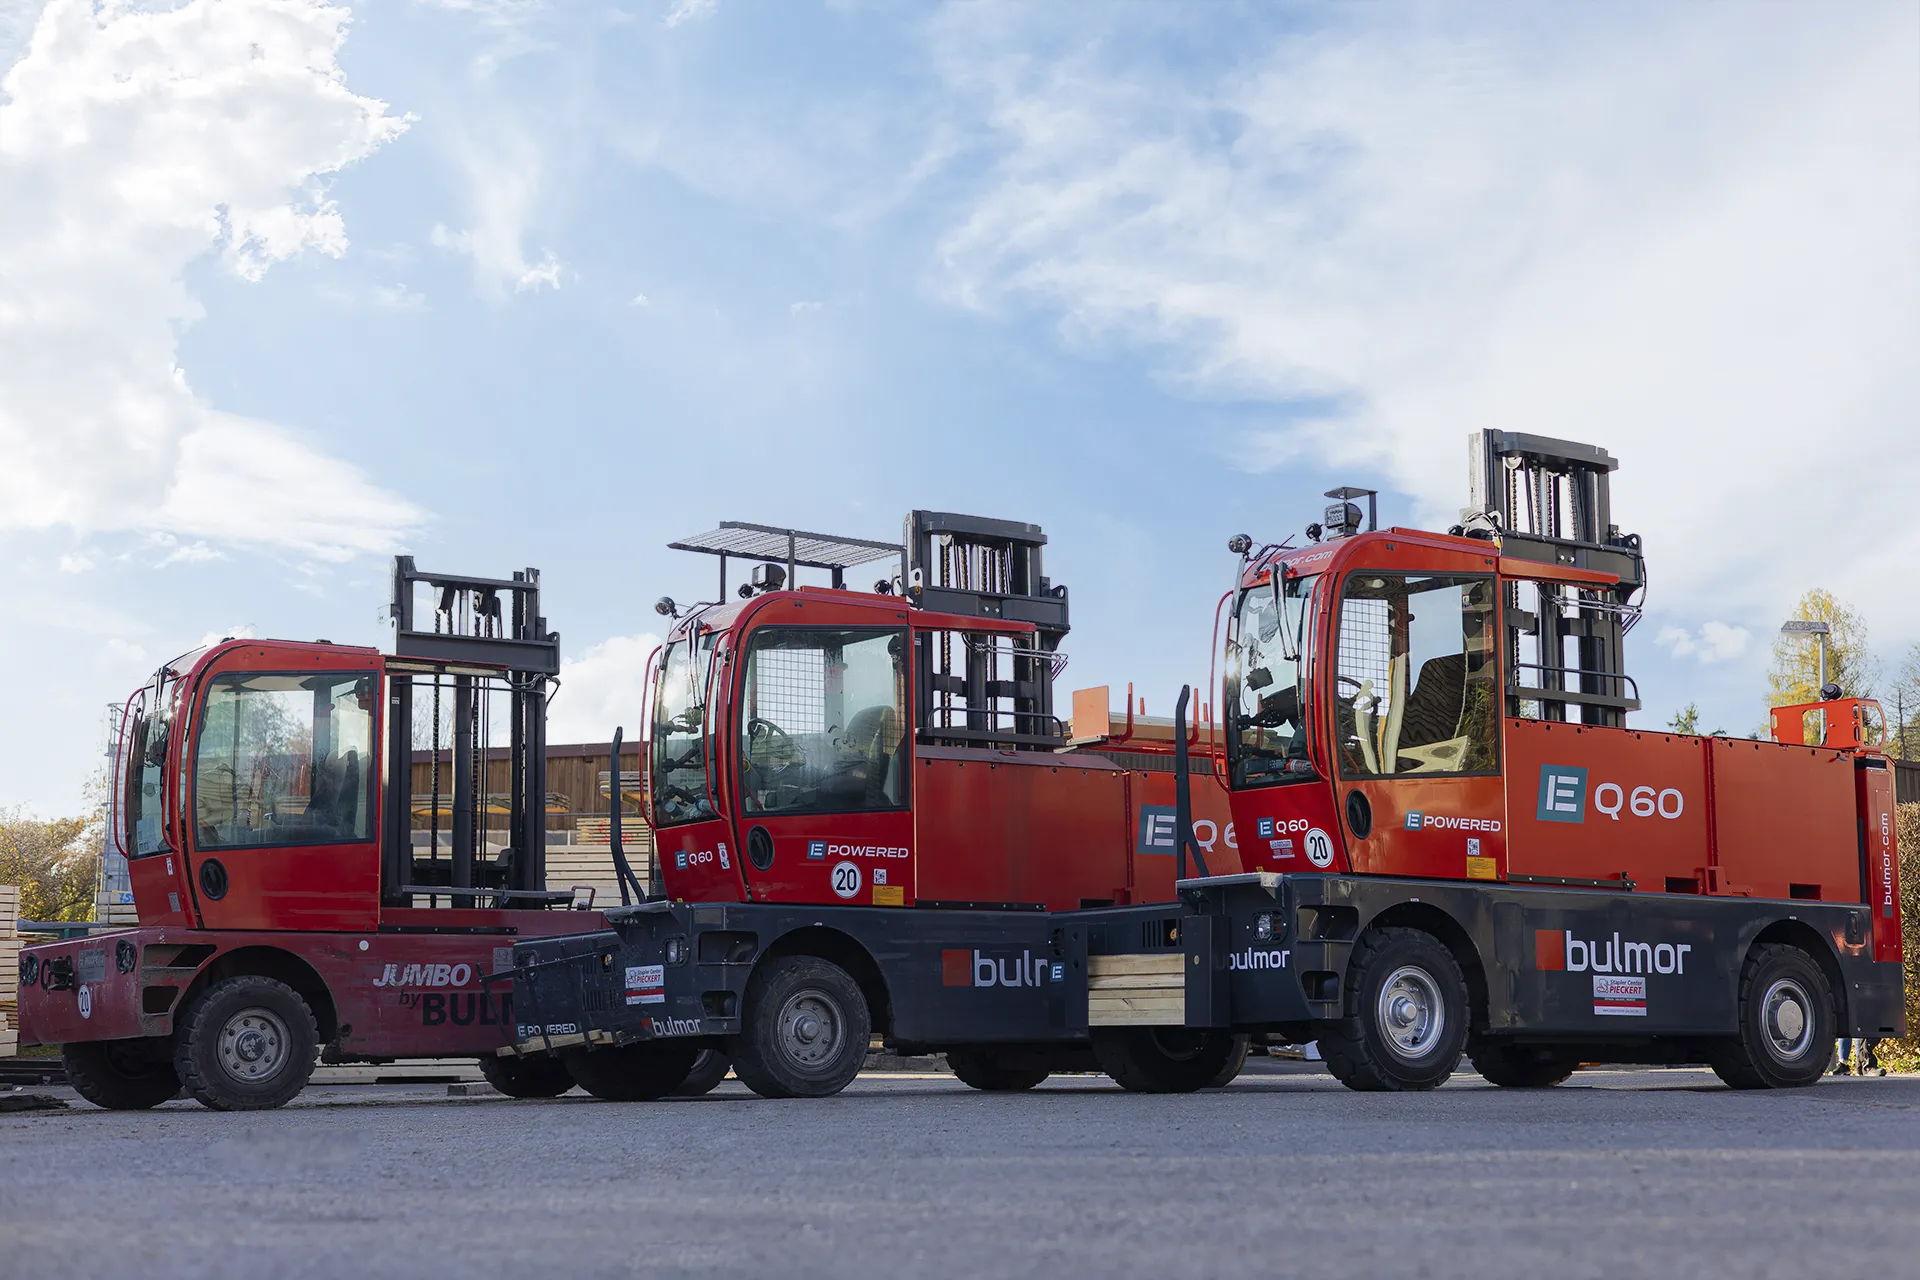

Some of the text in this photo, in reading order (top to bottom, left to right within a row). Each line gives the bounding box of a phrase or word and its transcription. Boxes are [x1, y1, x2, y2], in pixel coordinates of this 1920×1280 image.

[1546, 775, 1684, 821] E Q60
[1276, 818, 1309, 834] Q60
[1423, 815, 1501, 832] POWERED
[688, 850, 713, 866] Q60
[827, 845, 909, 858] POWERED
[1309, 836, 1328, 860] 20
[1882, 812, 1893, 905] bulmor.com
[835, 868, 857, 892] 20
[1565, 930, 1692, 974] bulmor
[372, 963, 472, 987] JUMBO
[400, 988, 421, 1008] by
[1609, 985, 1643, 994] PIECKERT
[527, 1022, 577, 1036] POERED
[651, 1015, 701, 1036] bulmor
